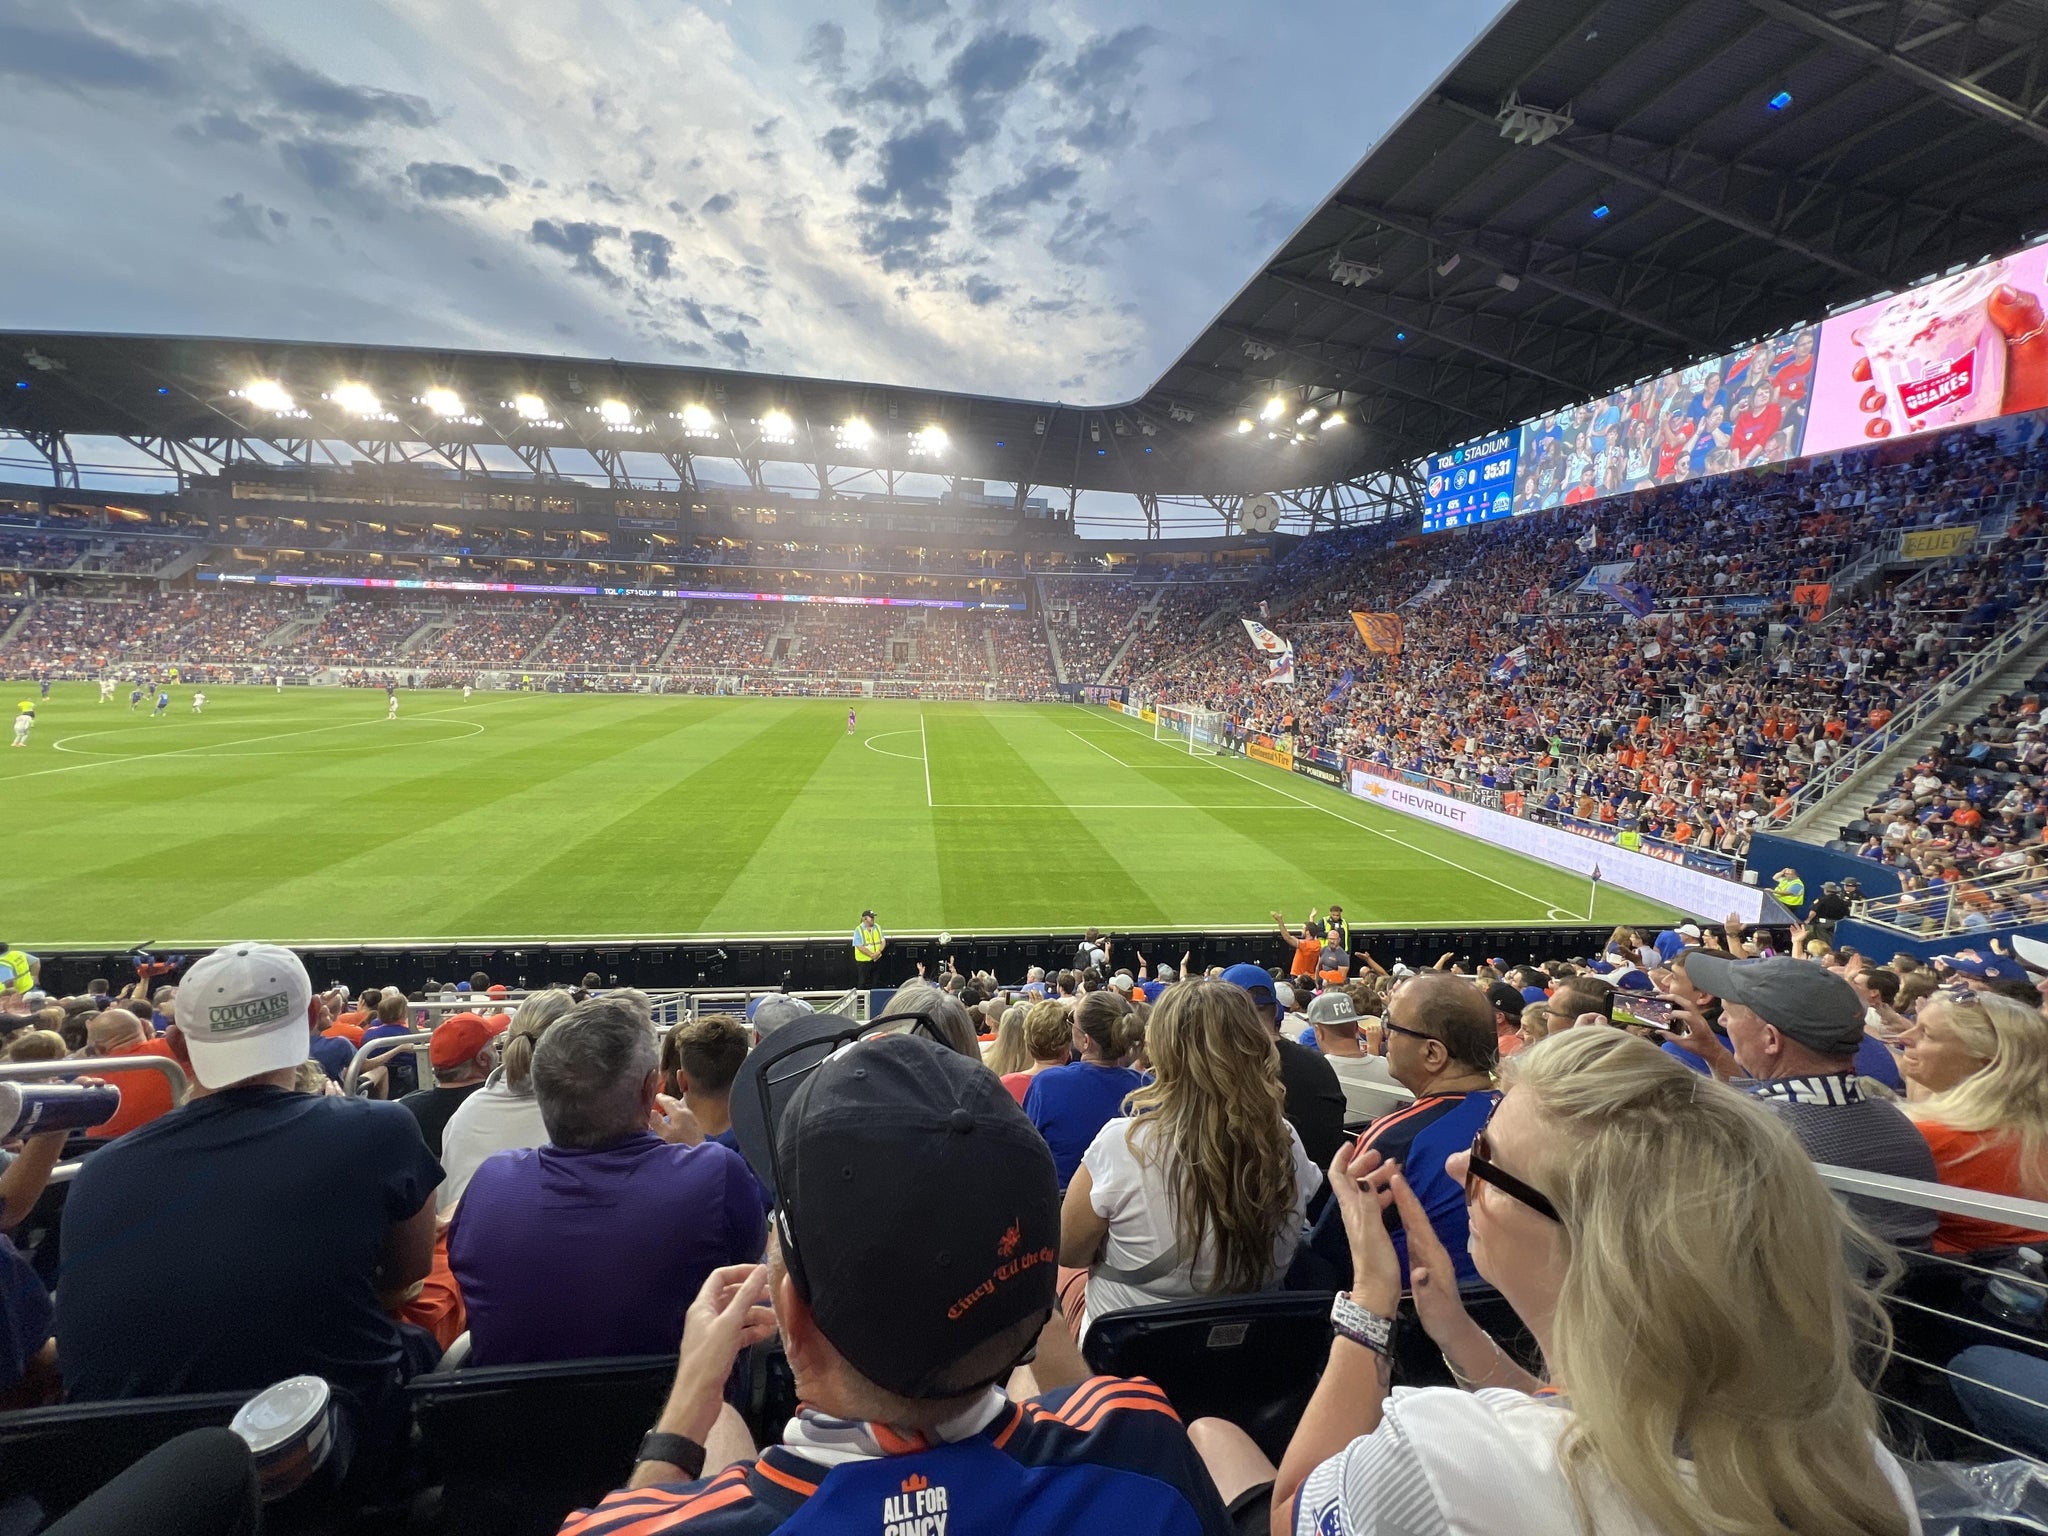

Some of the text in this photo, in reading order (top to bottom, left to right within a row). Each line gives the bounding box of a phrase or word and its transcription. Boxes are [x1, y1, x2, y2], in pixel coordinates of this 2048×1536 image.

[1437, 436, 1509, 470] TQL STADIUM
[1444, 459, 1511, 492] 1 0 35:31
[1905, 530, 1973, 554] BELIEVE
[603, 587, 618, 596] TQL
[625, 588, 658, 597] STADIUM
[1391, 789, 1467, 822] CHEVROLET
[209, 994, 289, 1024] COUGARS
[947, 1279, 996, 1319] Cincy
[883, 1486, 948, 1525] ALL FOR
